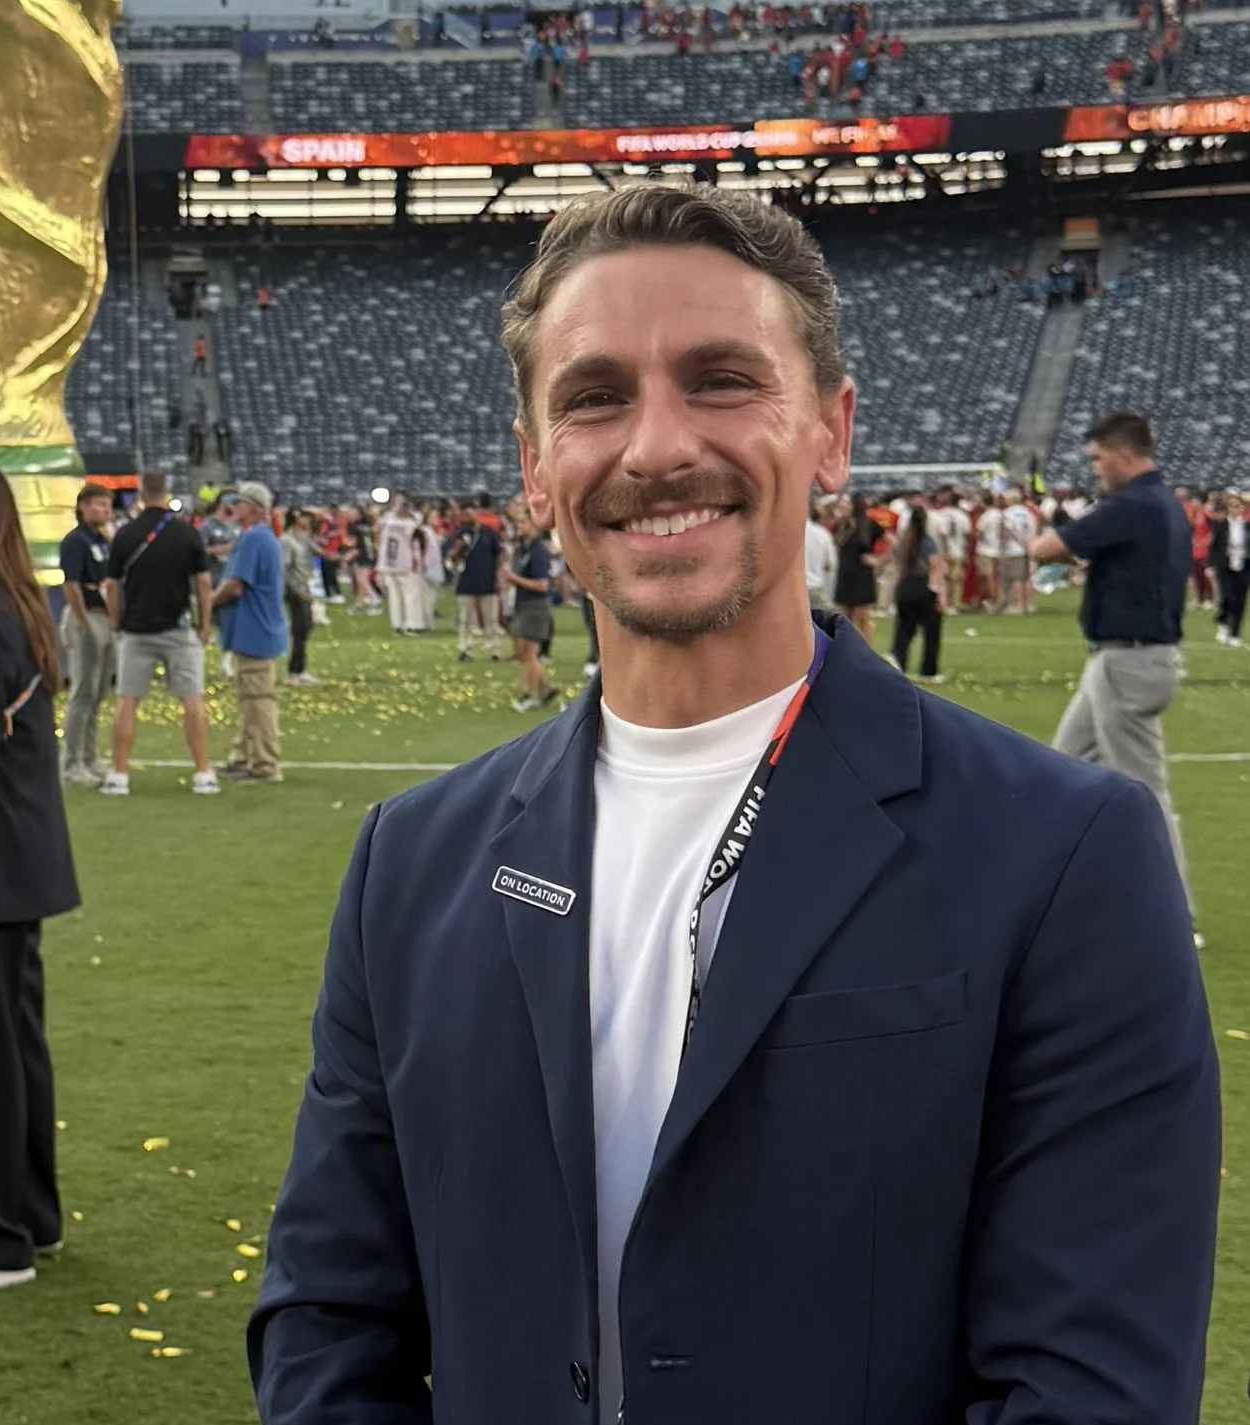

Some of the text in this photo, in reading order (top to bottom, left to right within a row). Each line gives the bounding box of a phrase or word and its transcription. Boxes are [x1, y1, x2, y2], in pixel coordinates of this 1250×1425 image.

[281, 138, 367, 163] SPAIN
[500, 875, 566, 907] ON LOCATION
